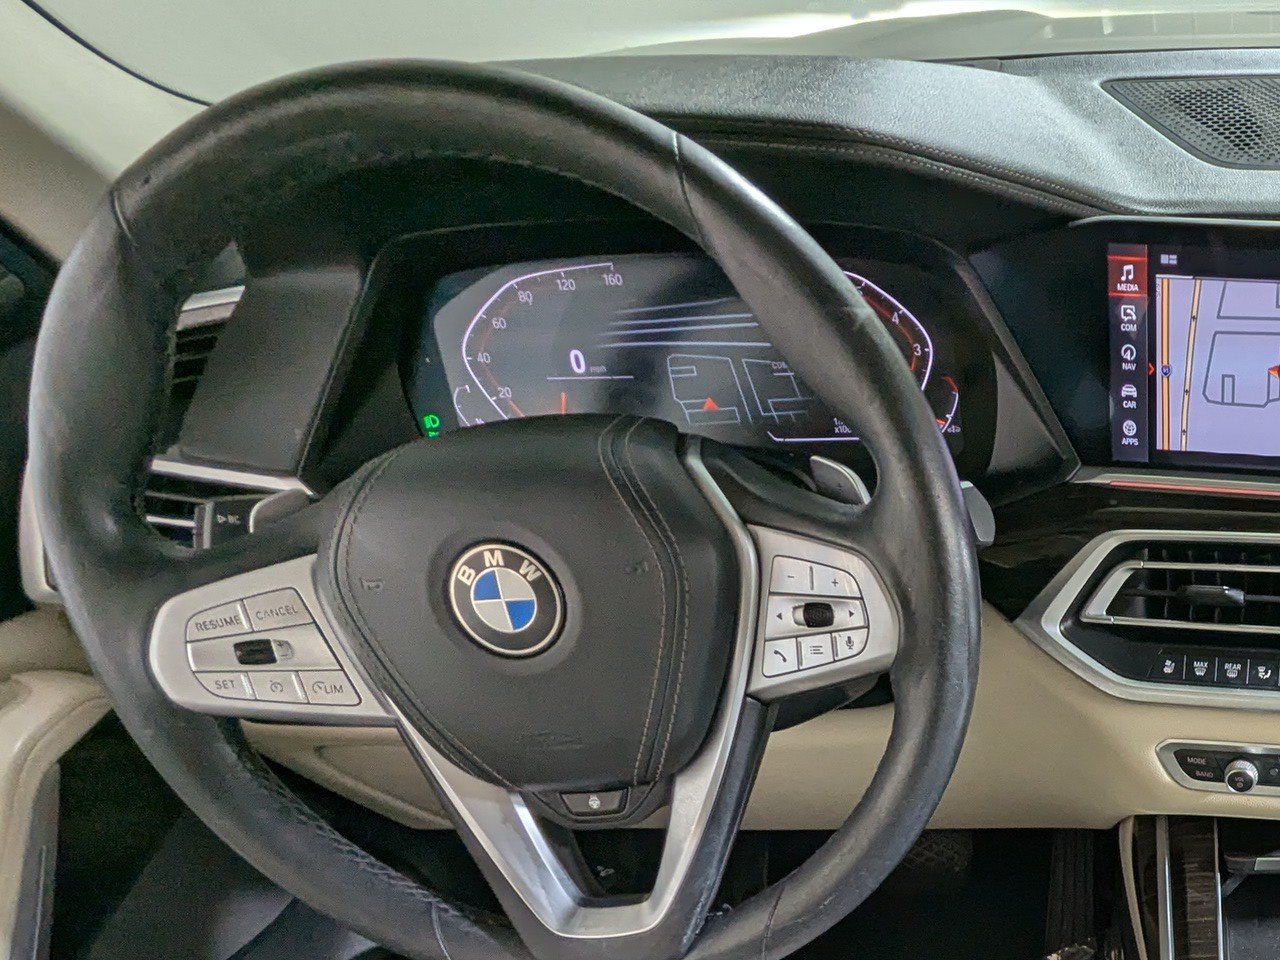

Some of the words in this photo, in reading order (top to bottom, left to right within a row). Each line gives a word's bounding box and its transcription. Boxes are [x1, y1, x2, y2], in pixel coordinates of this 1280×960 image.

[557, 278, 576, 291] 120
[603, 273, 624, 286] 160
[1117, 283, 1139, 292] MEDIA
[518, 290, 533, 303] 80
[492, 317, 507, 329] 60
[892, 312, 899, 325] 4
[1120, 323, 1137, 332] COM
[913, 343, 922, 356] 3
[477, 353, 491, 364] 40
[569, 349, 586, 374] 0
[1122, 363, 1137, 371] NAV
[498, 386, 512, 398] 20
[1122, 400, 1137, 409] CAR
[1121, 437, 1139, 446] APPS
[457, 549, 542, 586] BMW
[255, 604, 299, 621] CANCEL
[195, 614, 243, 632] RESUME
[1193, 661, 1208, 669] MAX
[1224, 663, 1242, 671] REAR
[215, 680, 236, 690] SET
[324, 683, 344, 694] LIM
[1187, 756, 1206, 765] MODE
[1195, 770, 1214, 778] BAND
